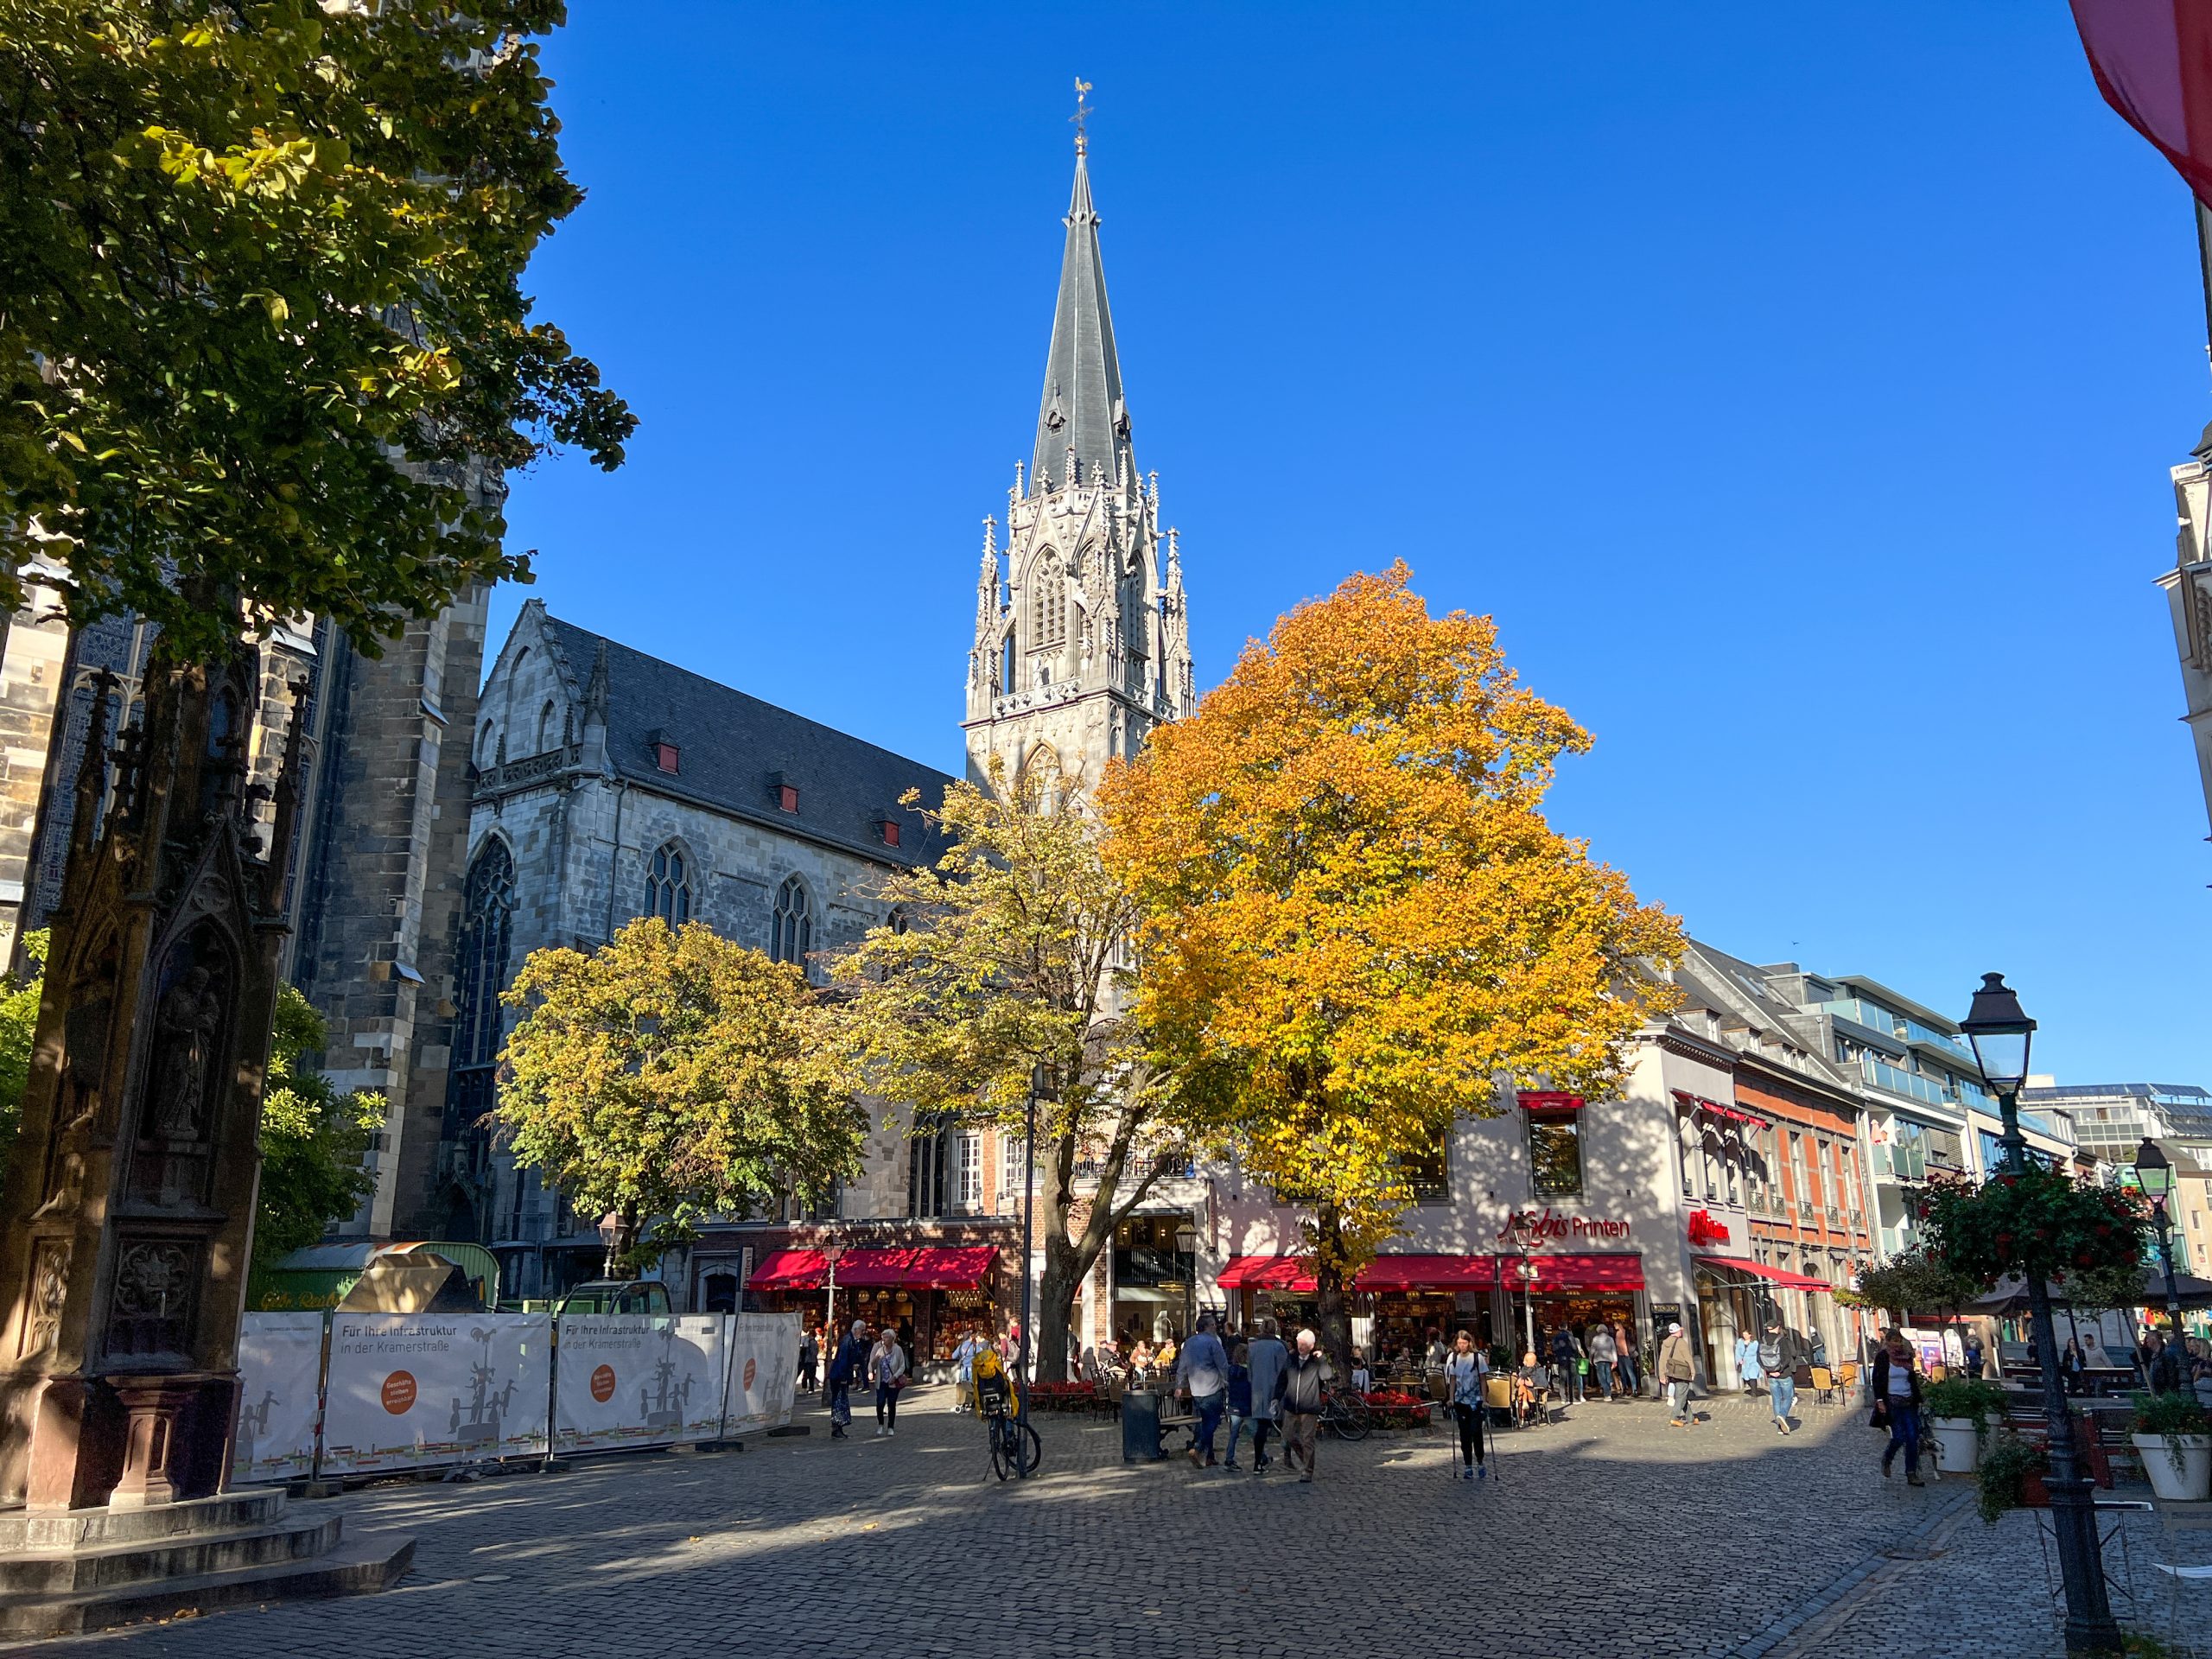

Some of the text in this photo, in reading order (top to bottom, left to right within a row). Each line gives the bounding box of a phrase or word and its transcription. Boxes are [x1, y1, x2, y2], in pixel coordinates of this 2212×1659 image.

[1573, 1217, 1630, 1236] Printen
[342, 1325, 457, 1338] Für Ihre Infrastruktur
[566, 1325, 650, 1335] Für Ihre Infrastruktur
[340, 1340, 449, 1354] in der Krämerstraße
[573, 1341, 585, 1350] der
